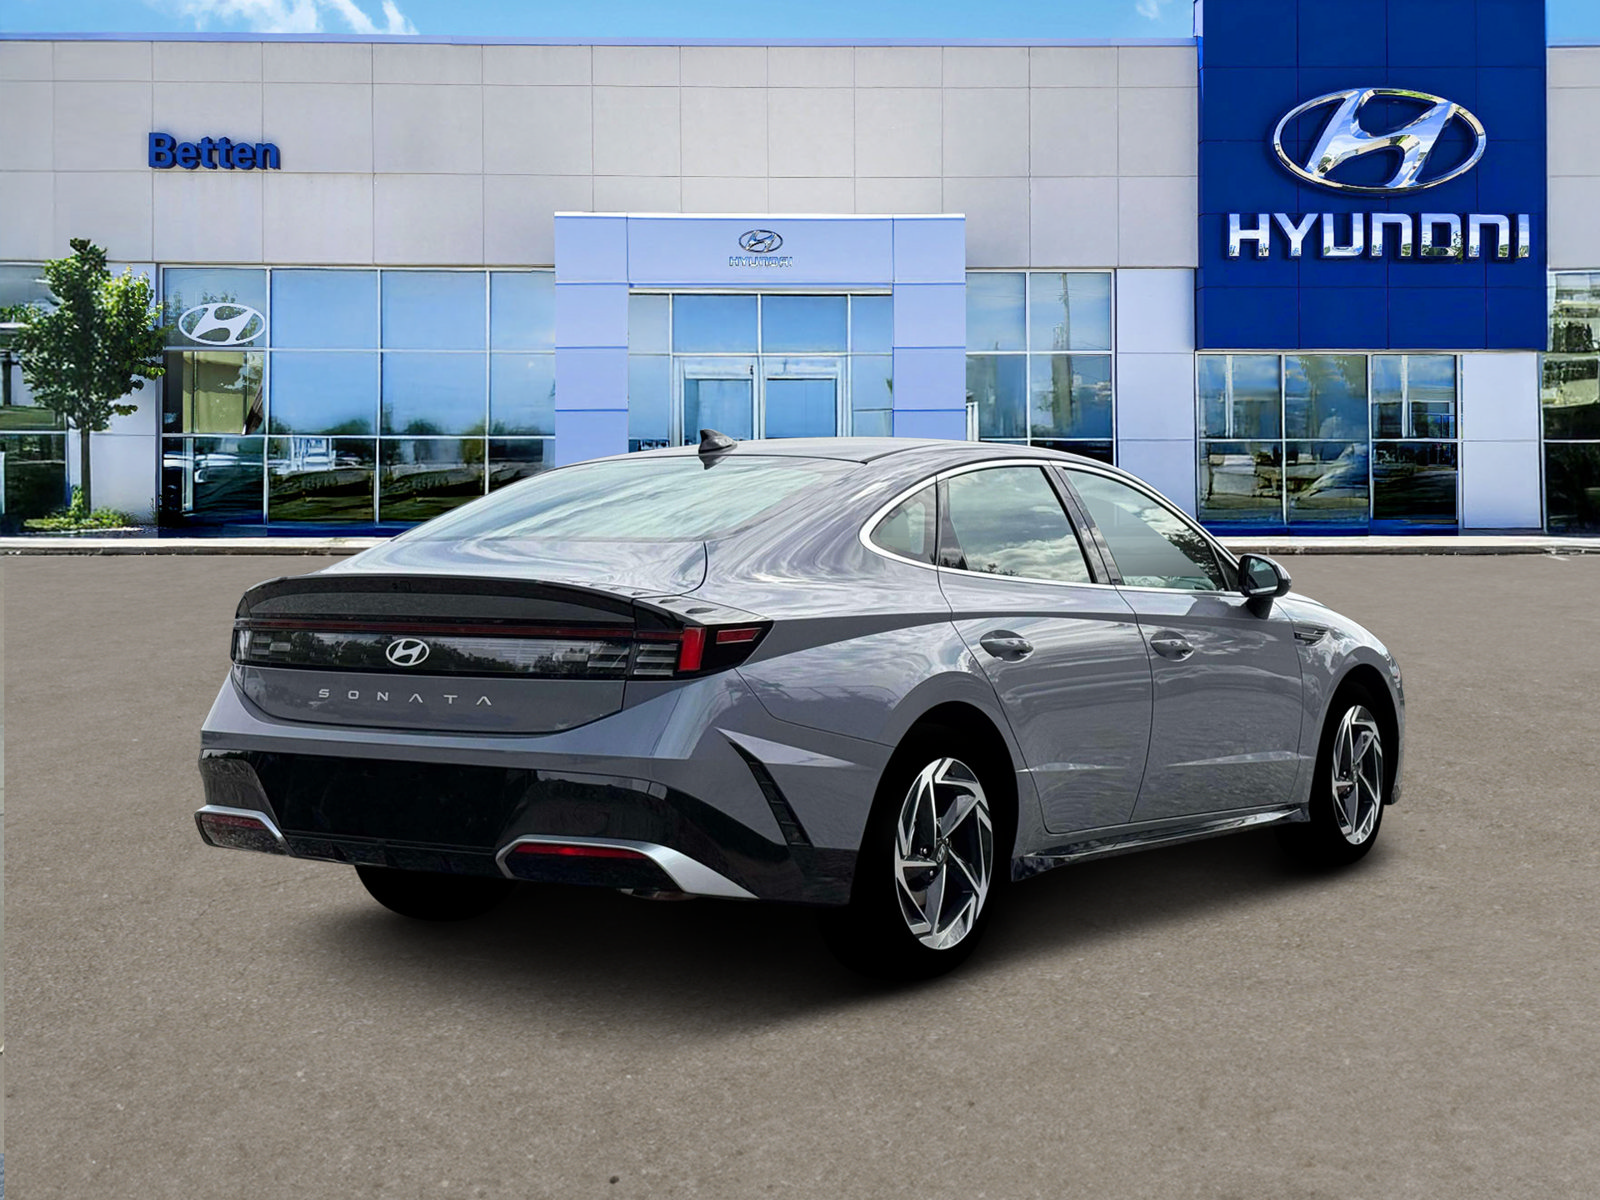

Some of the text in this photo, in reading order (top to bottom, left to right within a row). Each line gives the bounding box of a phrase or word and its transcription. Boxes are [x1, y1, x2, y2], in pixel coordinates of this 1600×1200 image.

[149, 132, 281, 169] Betten
[1228, 213, 1530, 258] HYUNDAI
[729, 256, 793, 268] HYUNDAI
[318, 688, 492, 706] SONATA
